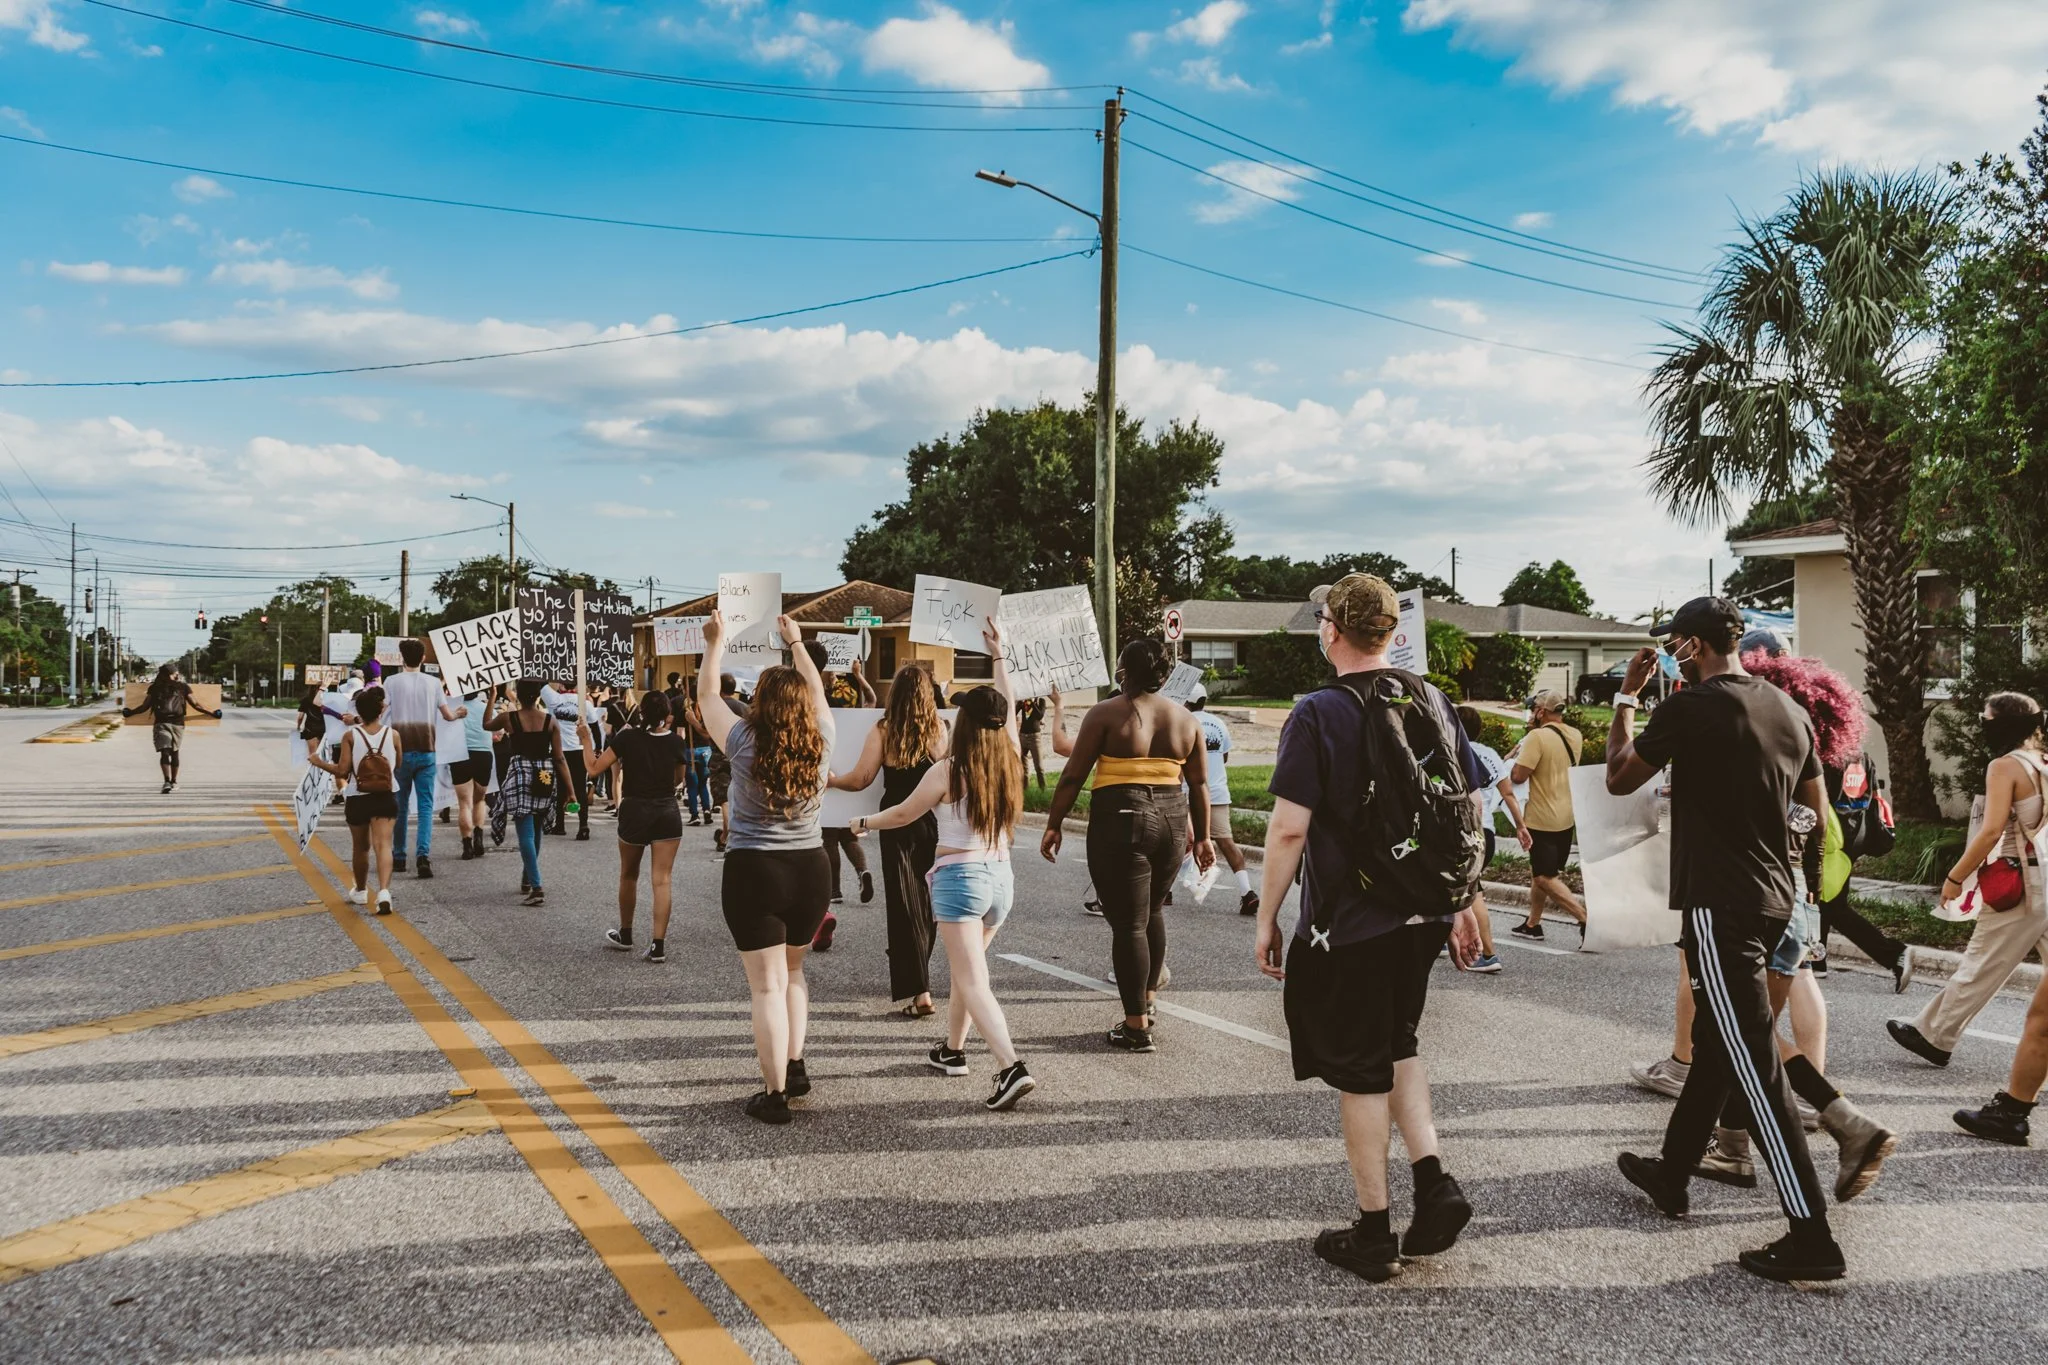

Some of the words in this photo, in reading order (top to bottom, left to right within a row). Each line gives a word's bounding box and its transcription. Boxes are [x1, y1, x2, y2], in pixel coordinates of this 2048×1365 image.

[720, 577, 750, 596] Black
[924, 588, 975, 622] Fuck
[523, 607, 547, 628] yo,
[551, 611, 565, 631] it
[675, 617, 702, 625] CAN'T
[724, 614, 747, 622] ives
[442, 613, 519, 655] BLACK
[522, 628, 567, 658] apply
[589, 637, 610, 652] me
[611, 631, 634, 654] And
[935, 619, 954, 644] 12
[465, 638, 521, 670] LIVES
[522, 647, 561, 670] Lady
[1001, 641, 1058, 674] BLACK
[1060, 633, 1101, 664] LIVES
[457, 660, 521, 694] MATTE
[523, 662, 549, 680] bitch
[1029, 662, 1092, 696] MATTER
[1845, 773, 1864, 787] STOP
